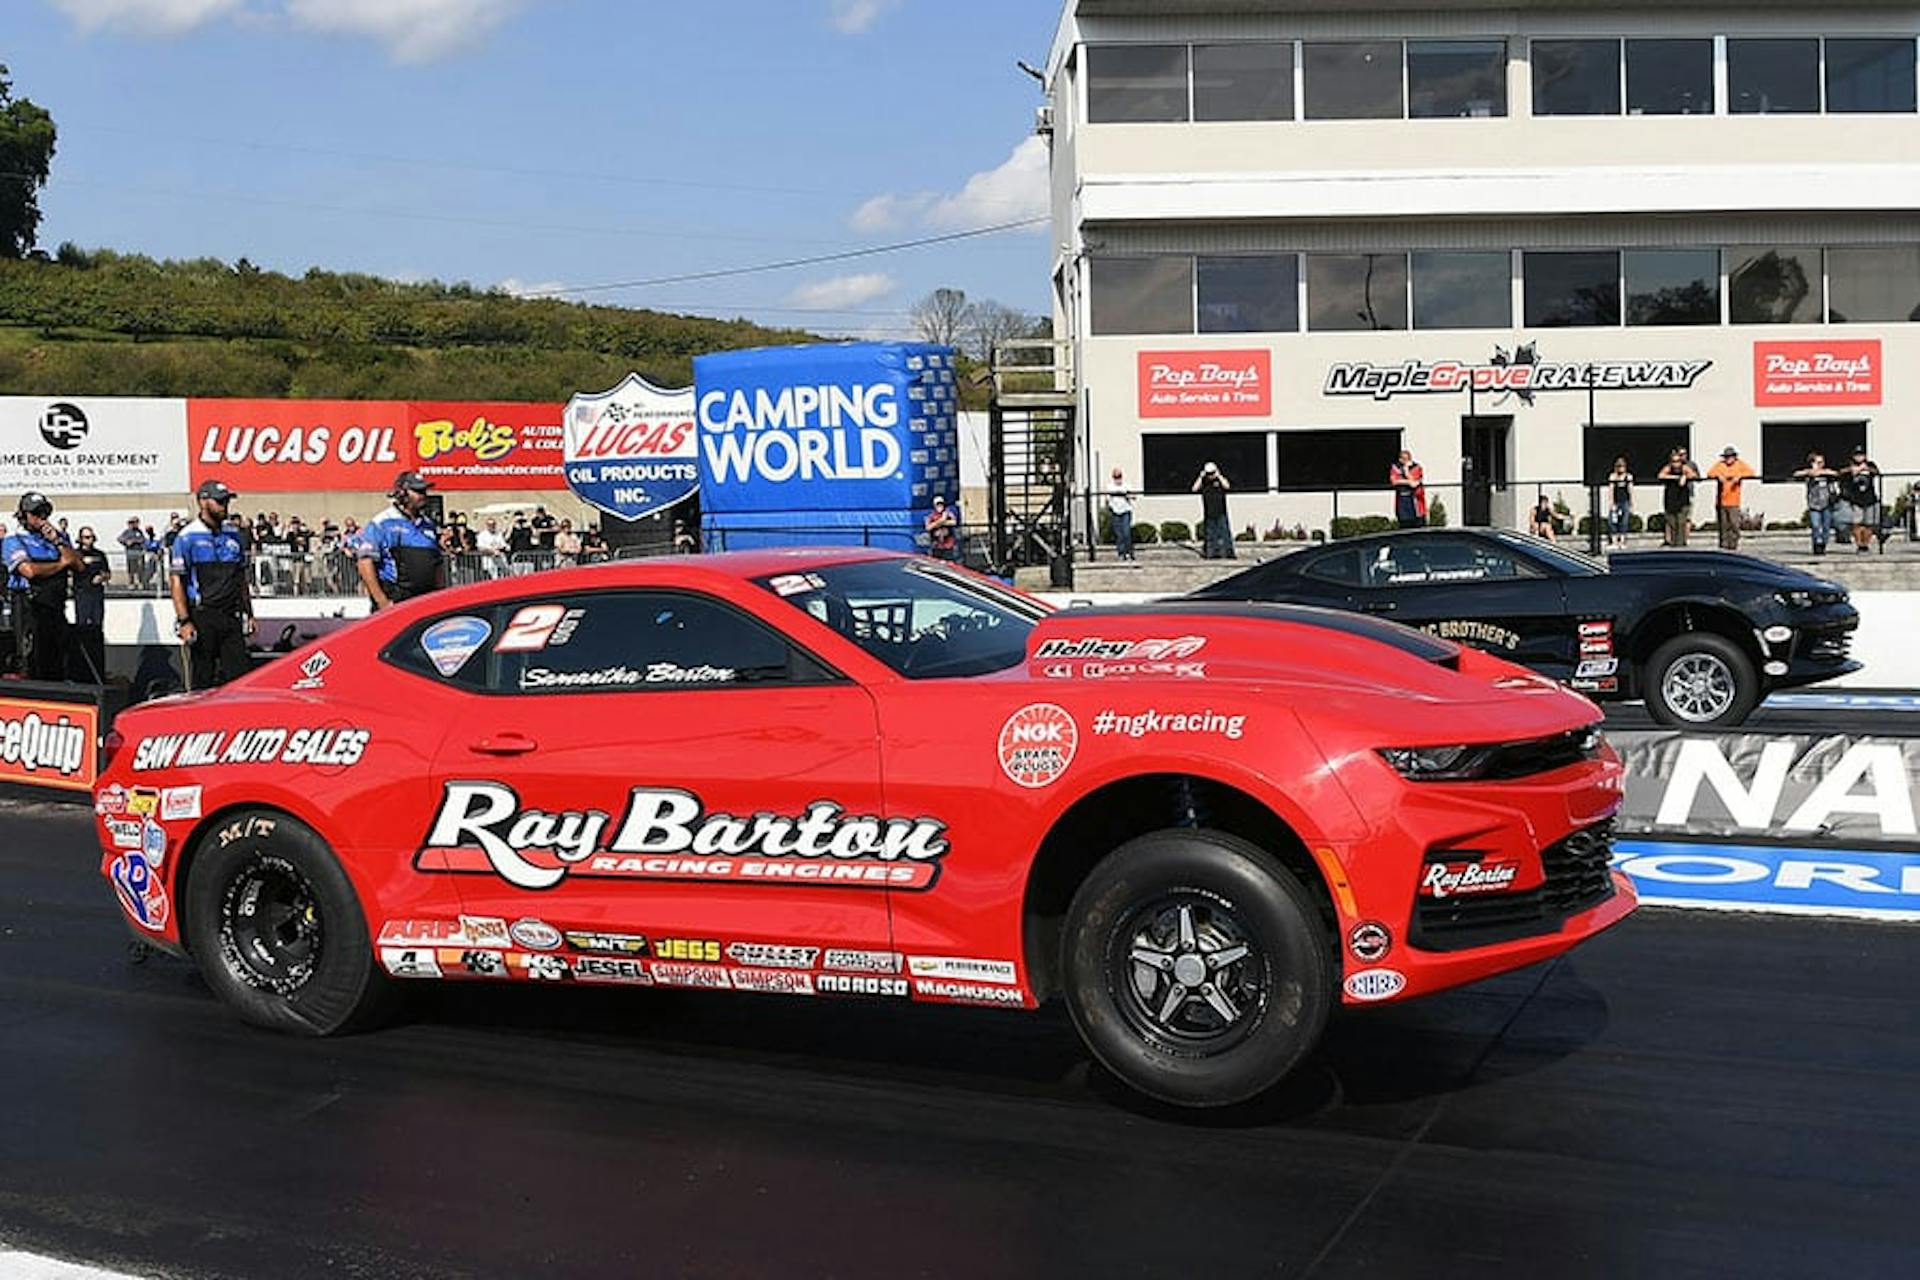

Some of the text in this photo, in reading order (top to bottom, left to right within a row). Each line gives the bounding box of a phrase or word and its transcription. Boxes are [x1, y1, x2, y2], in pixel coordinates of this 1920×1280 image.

[1199, 364, 1259, 388] Boys
[1535, 364, 1705, 384] RACEWAY
[1812, 353, 1870, 379] Boys
[1149, 391, 1260, 405] Auto Service & Tires
[1765, 382, 1872, 393] Auto Service & Tires
[700, 383, 898, 433] CAMPING
[200, 426, 396, 464] LUCAS OIL
[414, 417, 518, 460] Rob's
[522, 439, 533, 449] &
[576, 422, 693, 457] LUCAS
[0, 454, 159, 466] MERCIAL PAVEMENT
[702, 428, 901, 484] WORLD
[24, 468, 104, 476] SOLUTIONS
[569, 464, 697, 483] OIL PRODUCTS
[613, 487, 651, 502] INC.
[493, 604, 566, 653] 2
[1439, 620, 1520, 649] BROTHER'S
[1037, 638, 1131, 658] Holley
[519, 662, 736, 690] Samantha Barton
[1012, 722, 1064, 743] NGK
[1092, 709, 1246, 739] #ngkracing
[0, 712, 86, 775] eQuip
[132, 729, 371, 771] SAW MILL AUTO SALES
[1014, 749, 1060, 760] SPARK
[1013, 760, 1060, 771] PLUGS
[218, 816, 277, 848] M/T
[427, 781, 949, 888] Ray Barton
[592, 856, 914, 882] RACING ENGINES
[1422, 863, 1462, 898] Ray
[1608, 852, 1920, 894] OR
[654, 939, 721, 962] JEGS
[574, 960, 649, 978] JESEL
[735, 970, 805, 986] SIMPSON
[816, 975, 909, 996] MOROSO
[915, 980, 1024, 1002] MAGNUSON
[1350, 974, 1400, 996] NHRA
